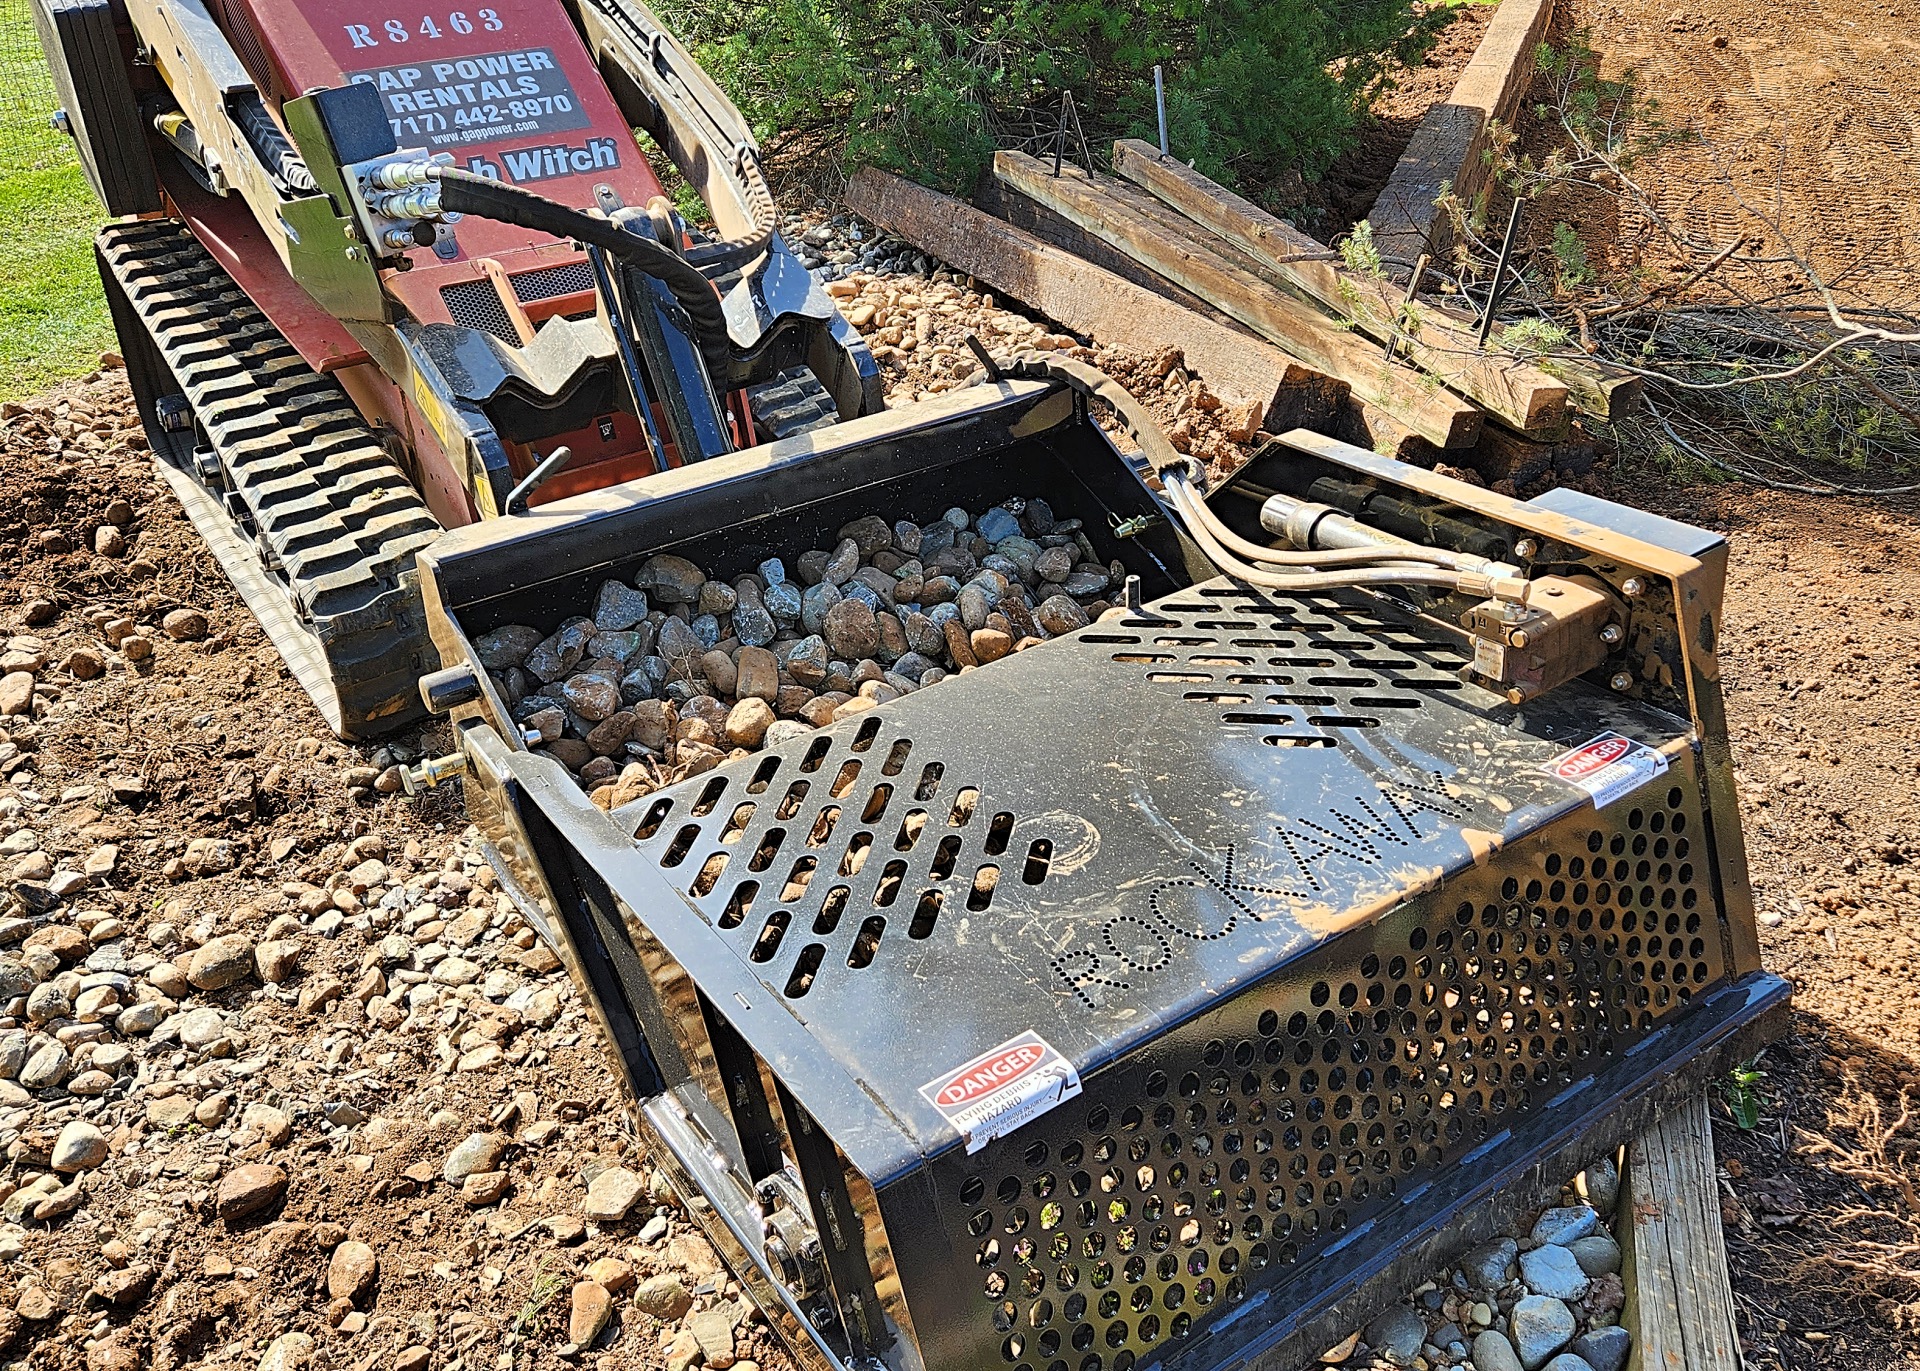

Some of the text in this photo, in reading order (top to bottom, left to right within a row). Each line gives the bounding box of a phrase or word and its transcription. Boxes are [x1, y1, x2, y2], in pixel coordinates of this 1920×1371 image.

[344, 8, 503, 49] R8463
[431, 51, 554, 83] POWER
[388, 75, 540, 113] RENTALS
[454, 94, 572, 127] 442-8970
[431, 120, 539, 145] www.gappower.com
[1562, 740, 1626, 775] DANGER
[1598, 769, 1629, 789] HAZARD
[944, 1047, 1038, 1103] DANGER
[955, 1079, 1031, 1126] FLYING DEBRIS
[974, 1121, 1000, 1140] PREVENT
[1000, 1109, 1024, 1125] SERIOUS
[1023, 1098, 1043, 1113] INJURY
[977, 1095, 1022, 1126] HAZARD
[1006, 1116, 1020, 1128] STAY
[1020, 1109, 1036, 1121] BACK
